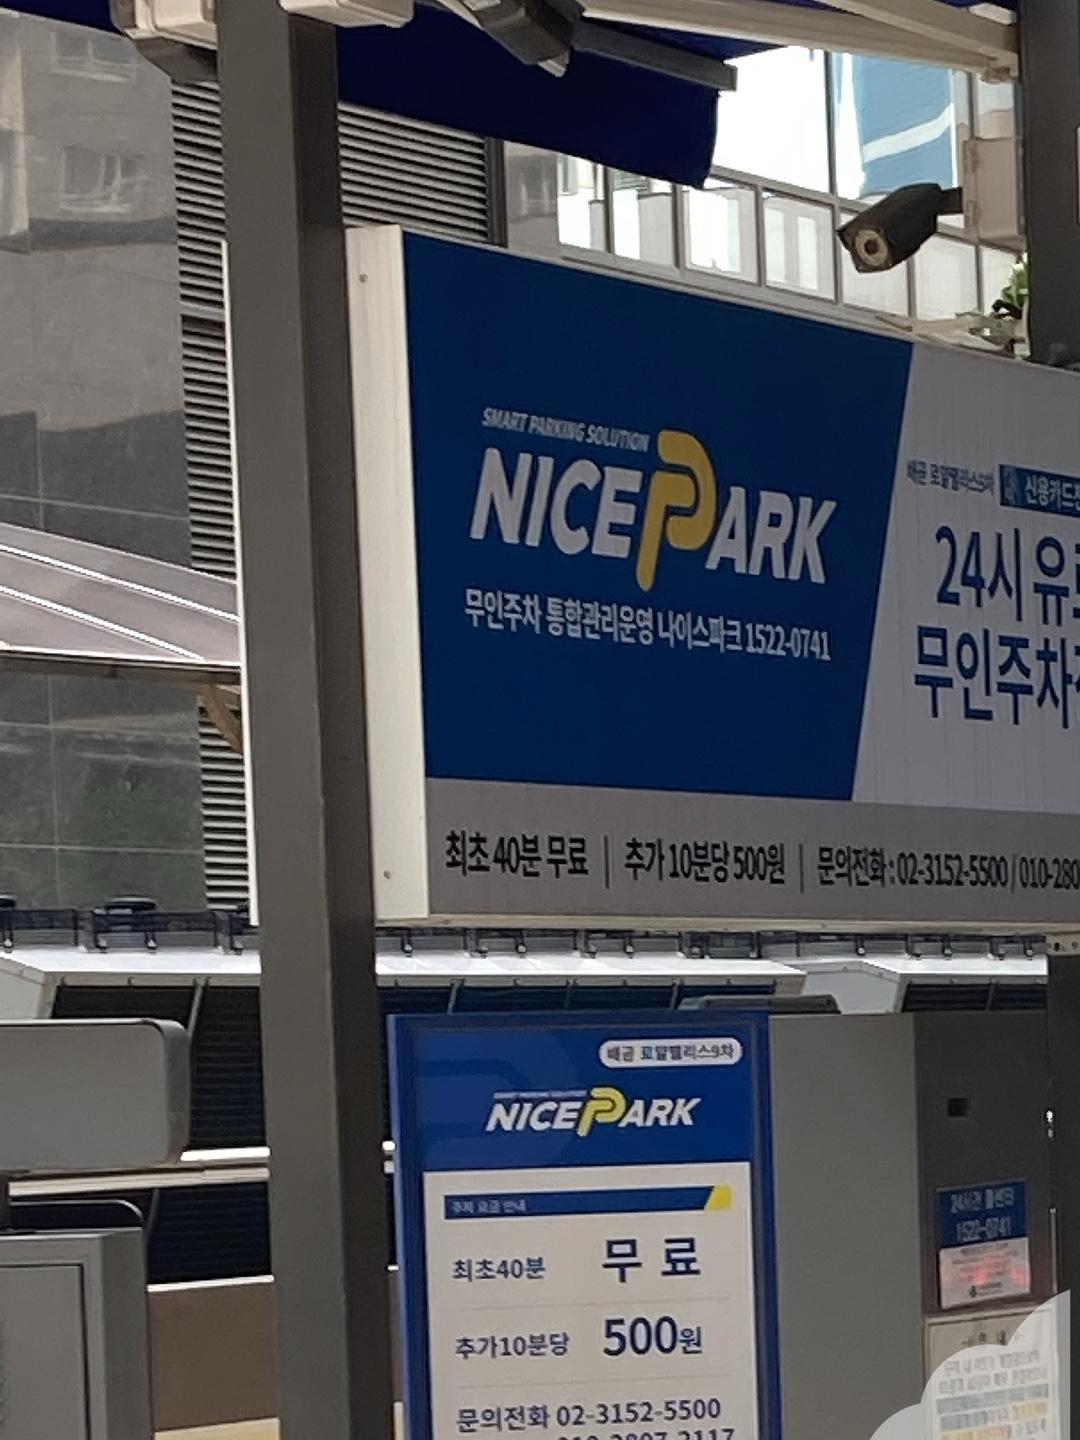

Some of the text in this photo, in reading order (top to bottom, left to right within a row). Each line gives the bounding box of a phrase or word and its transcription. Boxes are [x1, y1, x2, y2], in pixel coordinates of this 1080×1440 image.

[482, 407, 650, 452] SMART PARKING SOLUTION
[469, 429, 837, 592] NICEPARK
[935, 525, 1024, 623] 24시
[465, 588, 832, 662] 무인주차 통합관리운영 나이스파크 1522-0741
[547, 834, 590, 880] 무료
[624, 837, 666, 882] 추가
[669, 841, 732, 884] 10분당
[733, 842, 786, 885] 500원
[485, 1087, 702, 1137] NICEPARK
[602, 1315, 704, 1357] 500원
[457, 1398, 722, 1433] 문의전화 02-3152-5500
